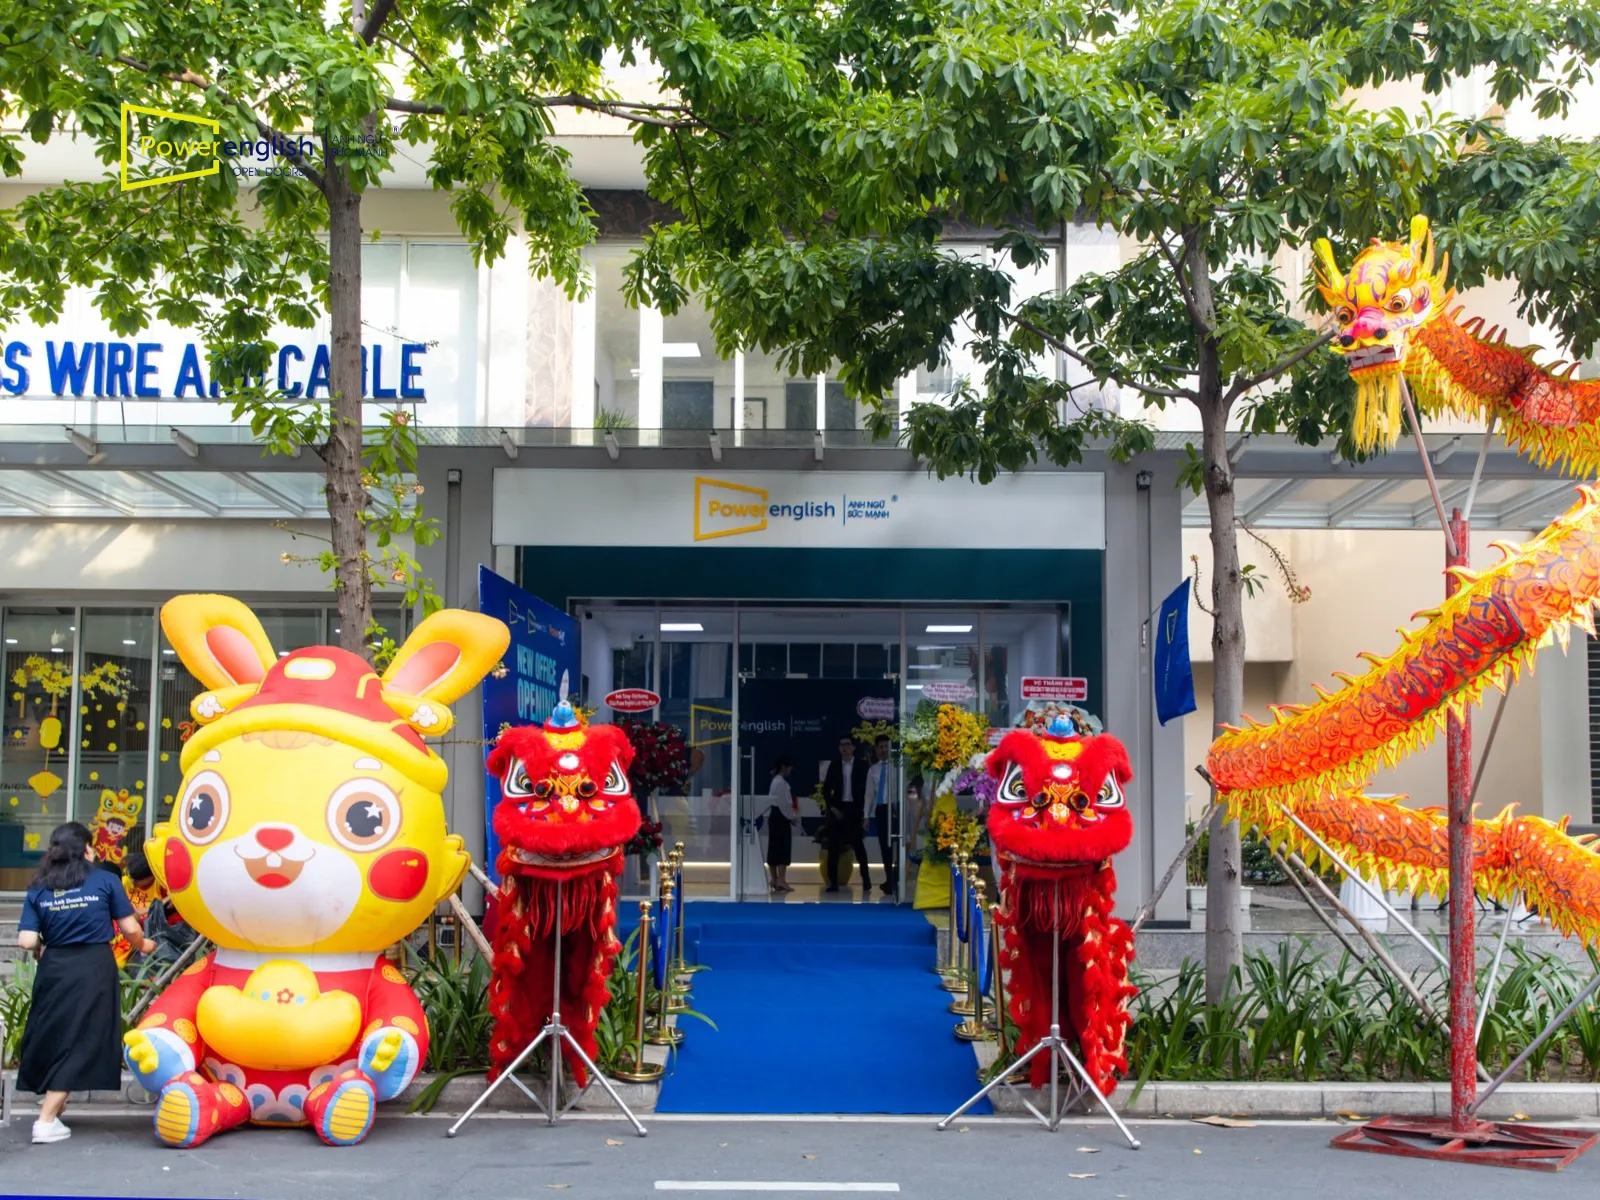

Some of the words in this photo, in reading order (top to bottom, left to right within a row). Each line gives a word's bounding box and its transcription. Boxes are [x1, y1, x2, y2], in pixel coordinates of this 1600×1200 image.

[45, 341, 163, 398] WIRE
[277, 344, 427, 398] CALE
[847, 501, 866, 509] ANH
[865, 510, 889, 521] MẠNH
[516, 643, 534, 678] NEW
[534, 651, 557, 687] OFFICE
